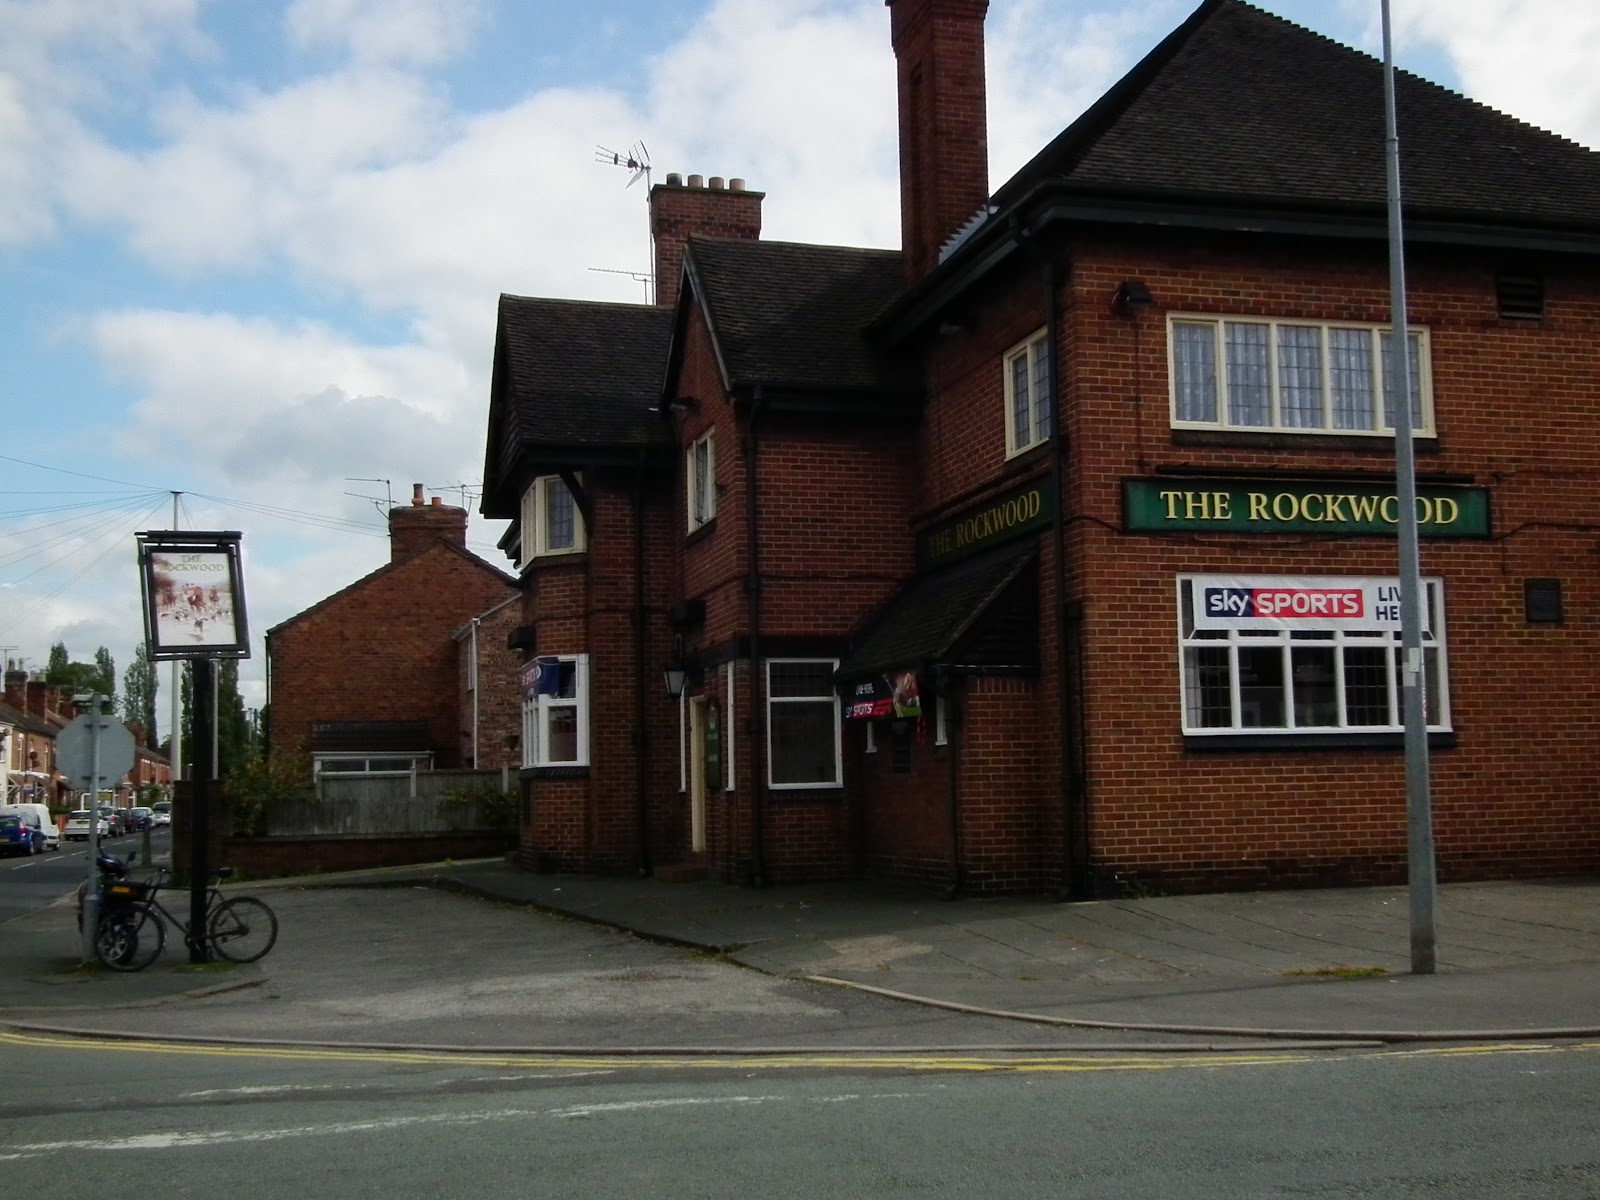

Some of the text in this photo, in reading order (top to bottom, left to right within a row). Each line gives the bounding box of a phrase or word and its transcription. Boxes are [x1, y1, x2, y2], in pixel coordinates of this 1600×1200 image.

[1160, 491, 1458, 524] THE ROCKWOOD
[928, 490, 1040, 559] THE ROCKWOOD
[180, 555, 202, 563] THE
[1210, 589, 1359, 616] sky SPORTS
[1378, 586, 1401, 602] LIV
